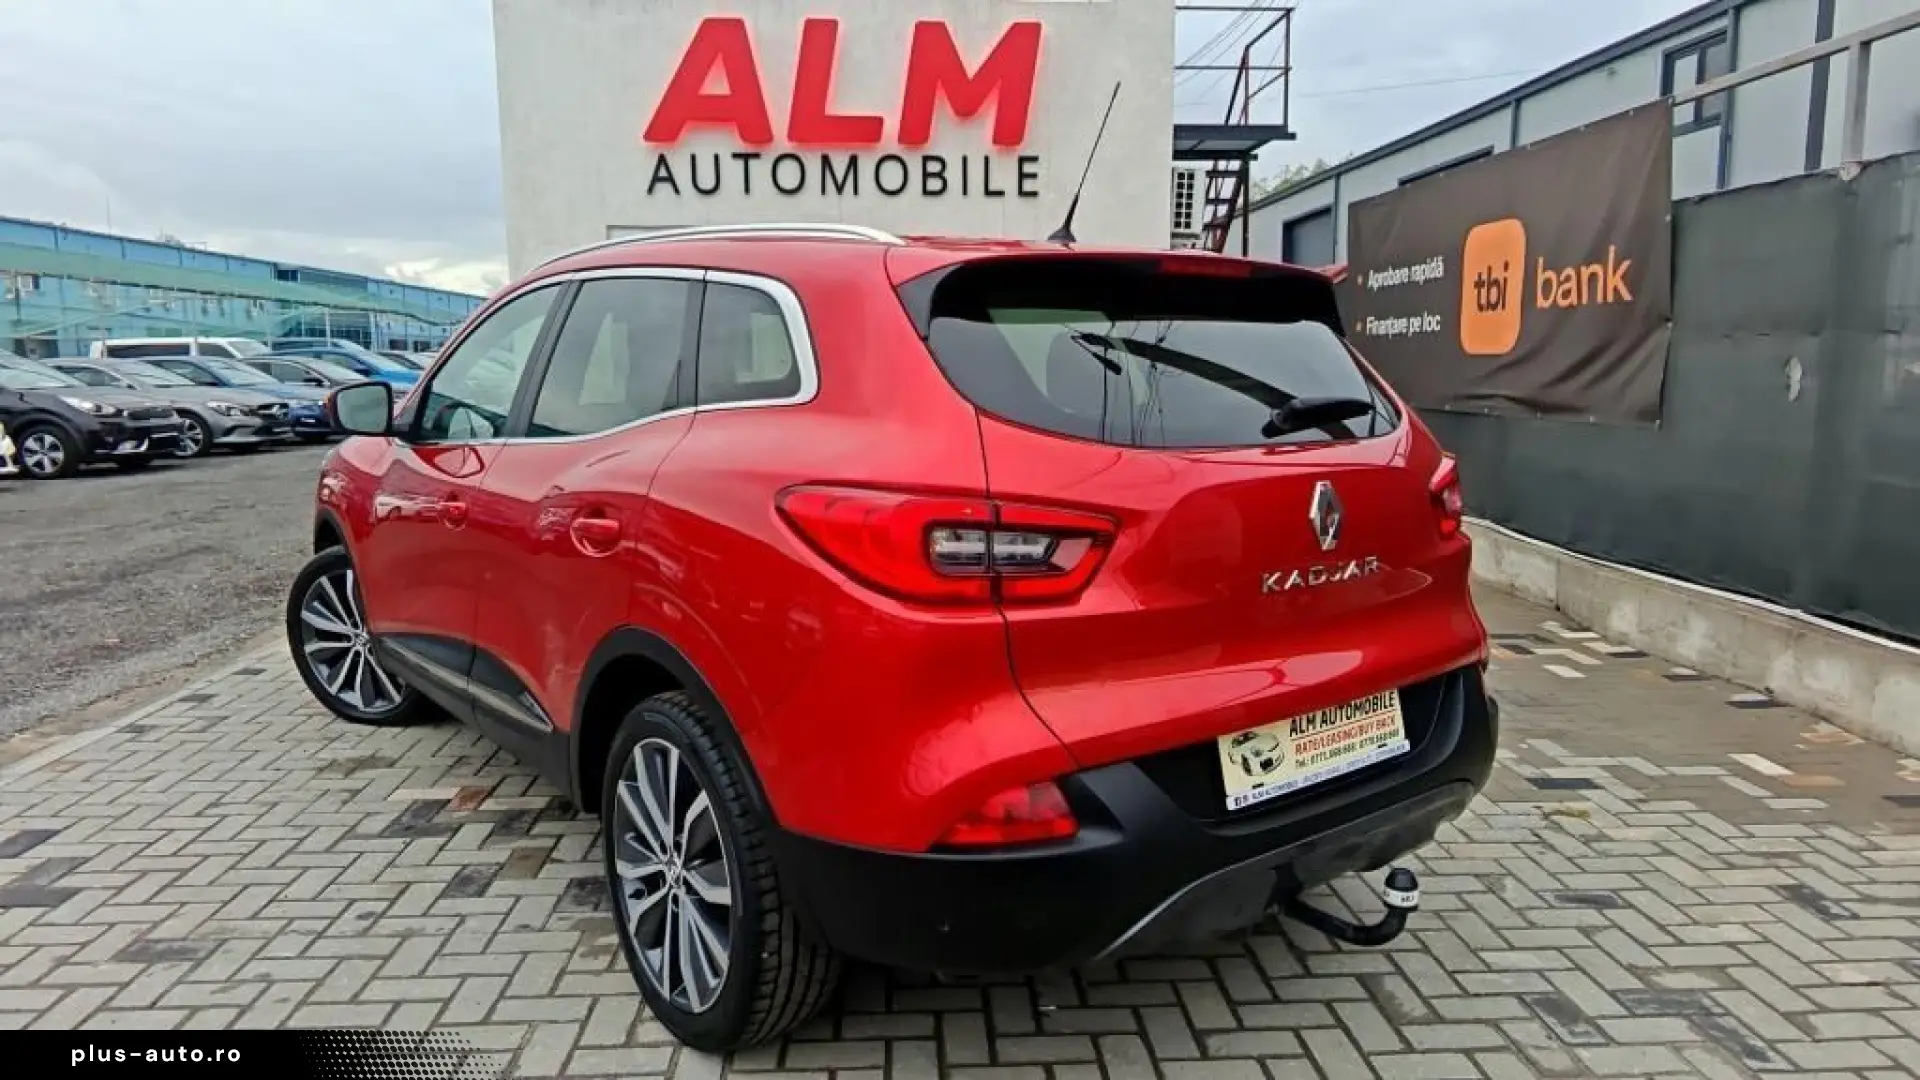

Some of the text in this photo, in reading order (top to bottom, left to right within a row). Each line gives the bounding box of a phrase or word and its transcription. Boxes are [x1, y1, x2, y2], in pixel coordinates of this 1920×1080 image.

[642, 16, 1042, 146] ALM
[647, 153, 1040, 197] AUTOMOBILE
[1367, 255, 1444, 291] Aprobare rapidă
[1473, 244, 1633, 313] tbi bank
[1366, 310, 1440, 339] Finanțare pe loc
[1262, 556, 1378, 593] KADJAR
[1290, 691, 1395, 737] ALM AUTOMOBILE
[1376, 714, 1396, 730] BACK
